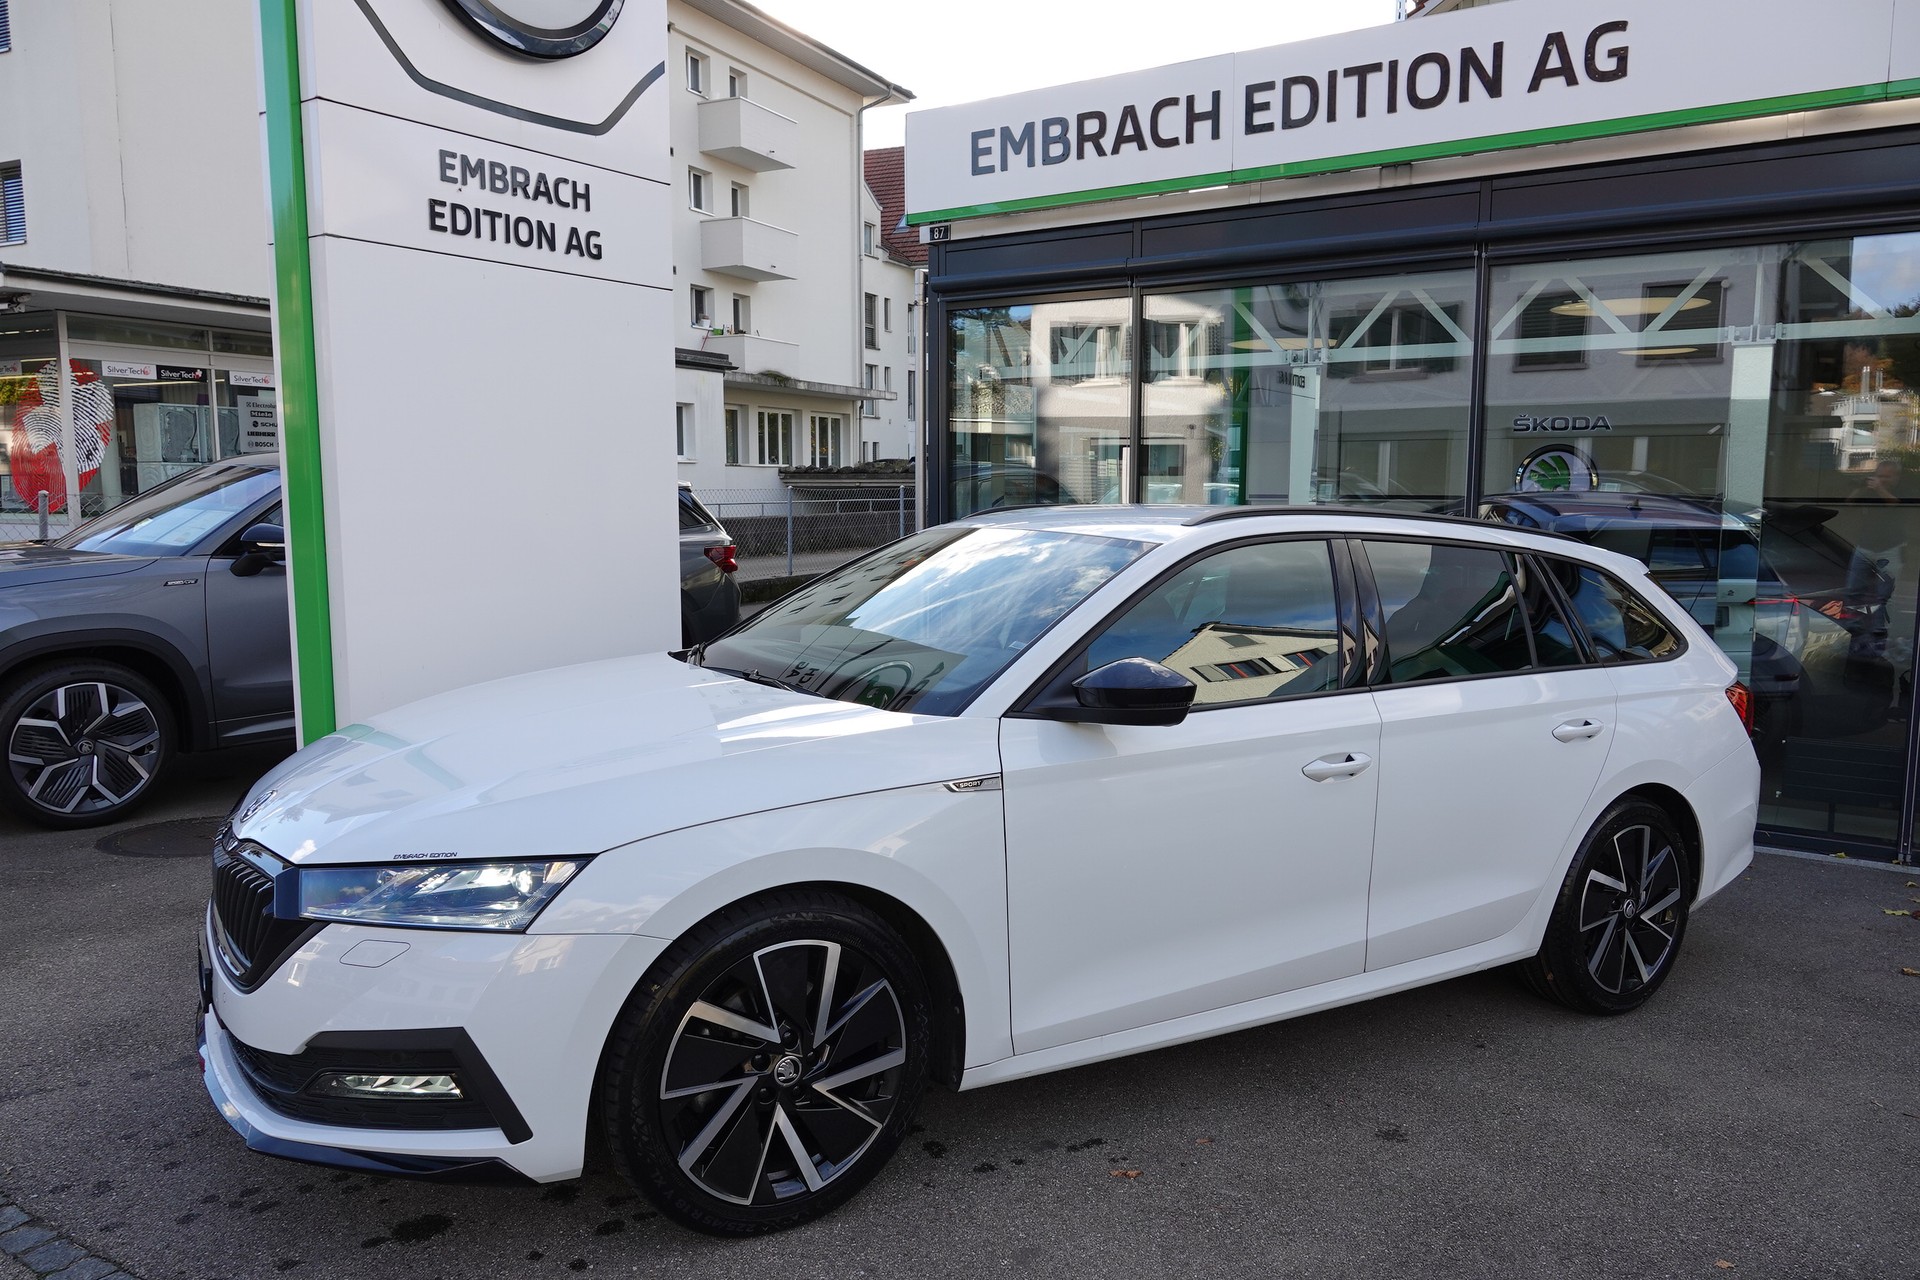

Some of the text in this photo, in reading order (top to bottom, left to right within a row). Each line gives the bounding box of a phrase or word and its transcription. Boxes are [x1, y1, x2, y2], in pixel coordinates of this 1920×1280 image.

[971, 20, 1629, 177] EMBRACH EDITION AG
[439, 149, 591, 212] EMBRACH
[428, 198, 603, 260] EDITION AG
[933, 227, 945, 239] 87
[107, 365, 146, 375] SilverTech
[161, 369, 197, 379] SilverTech
[234, 375, 265, 384] SilverTech
[1513, 414, 1612, 432] ŠKODA
